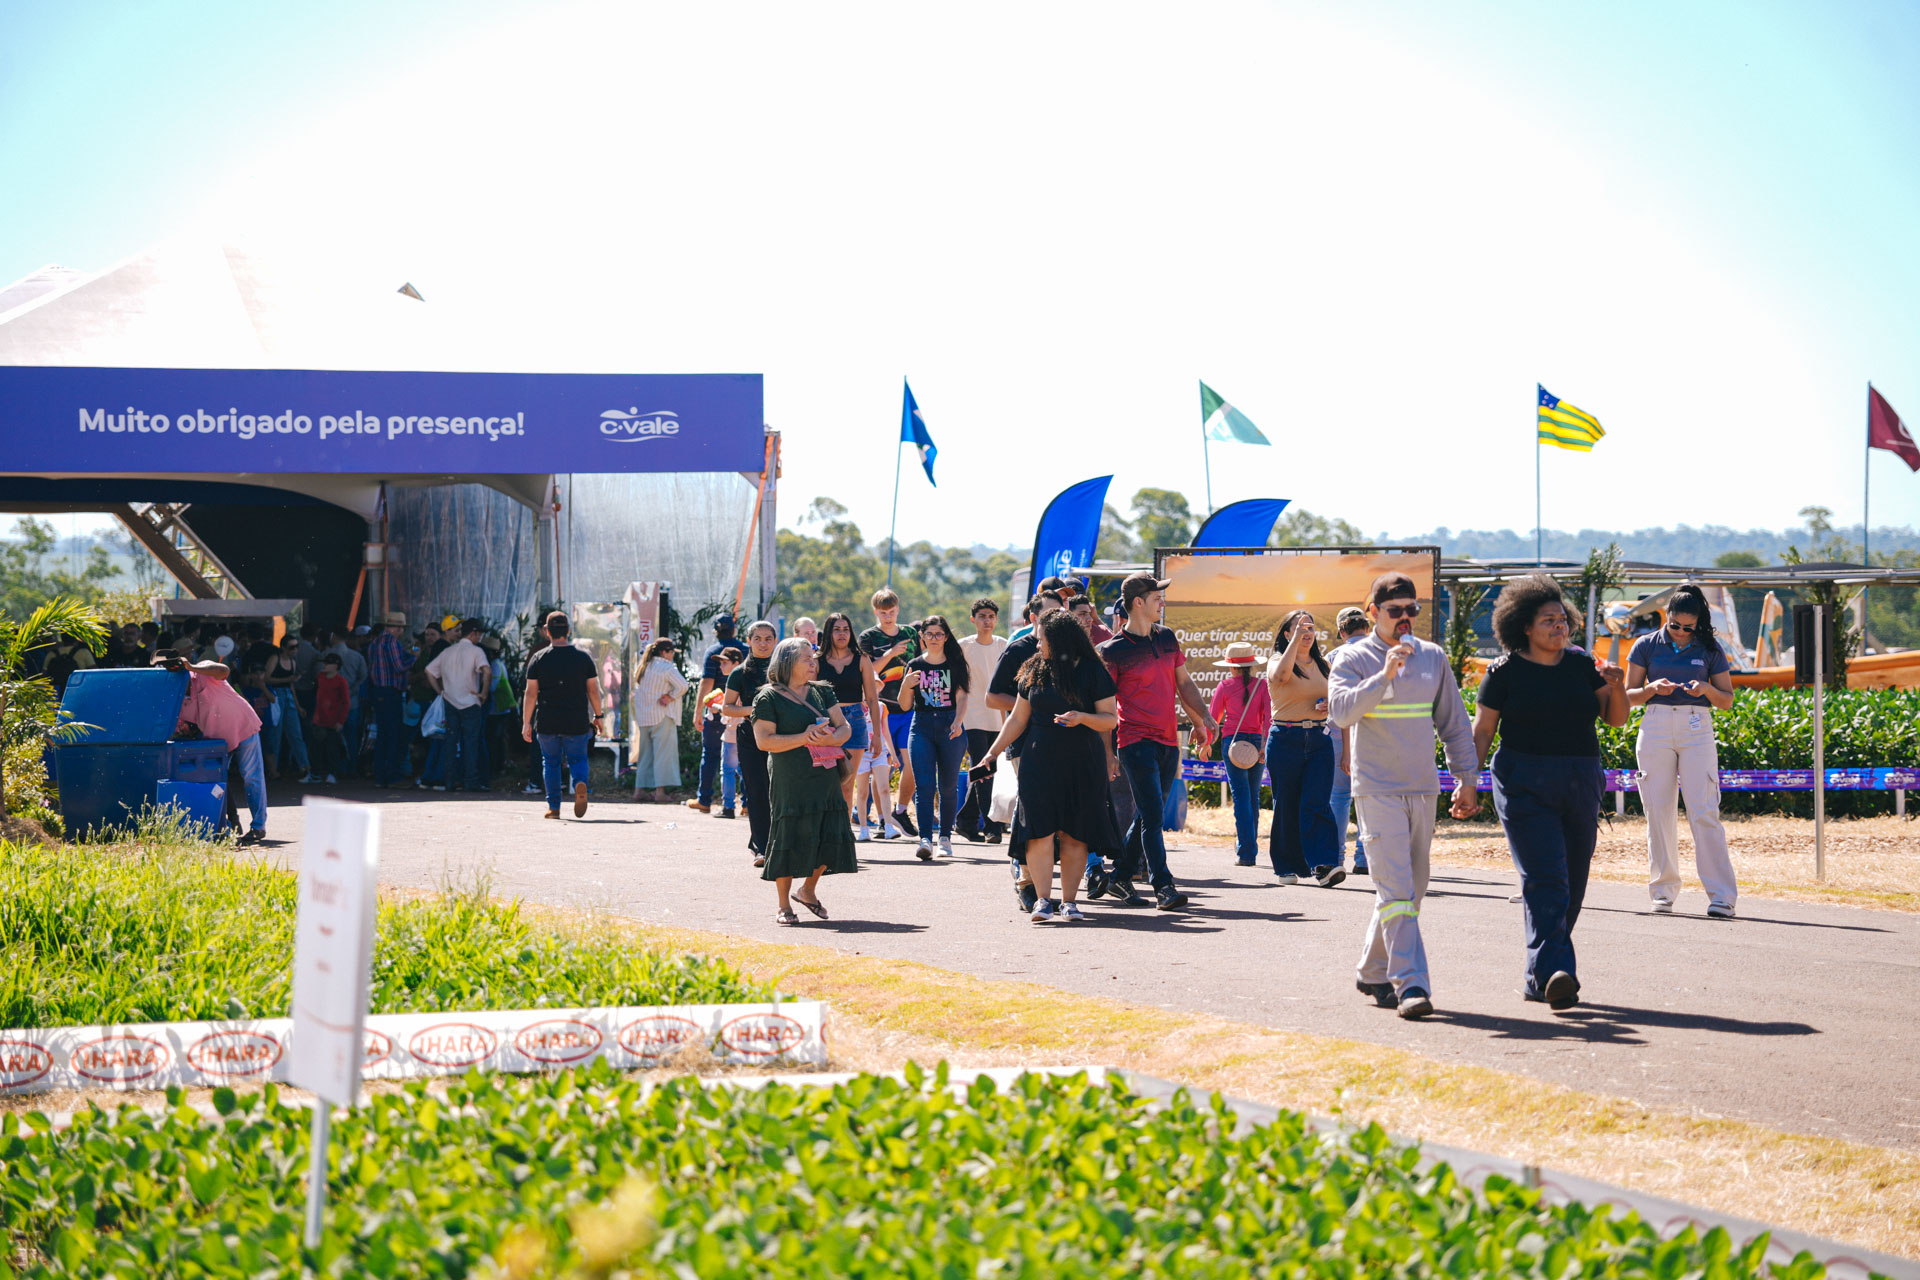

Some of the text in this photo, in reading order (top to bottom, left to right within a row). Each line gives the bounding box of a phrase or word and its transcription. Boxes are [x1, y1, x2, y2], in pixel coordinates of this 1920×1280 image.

[79, 406, 525, 441] Muito obrigado pela presença!
[1175, 628, 1273, 644] Quer tirar suas
[83, 1048, 159, 1069] IHARA
[199, 1043, 272, 1063] IHARA
[420, 1034, 488, 1053] IHARA
[525, 1031, 593, 1050] IHARA
[730, 1025, 794, 1042] IHARA
